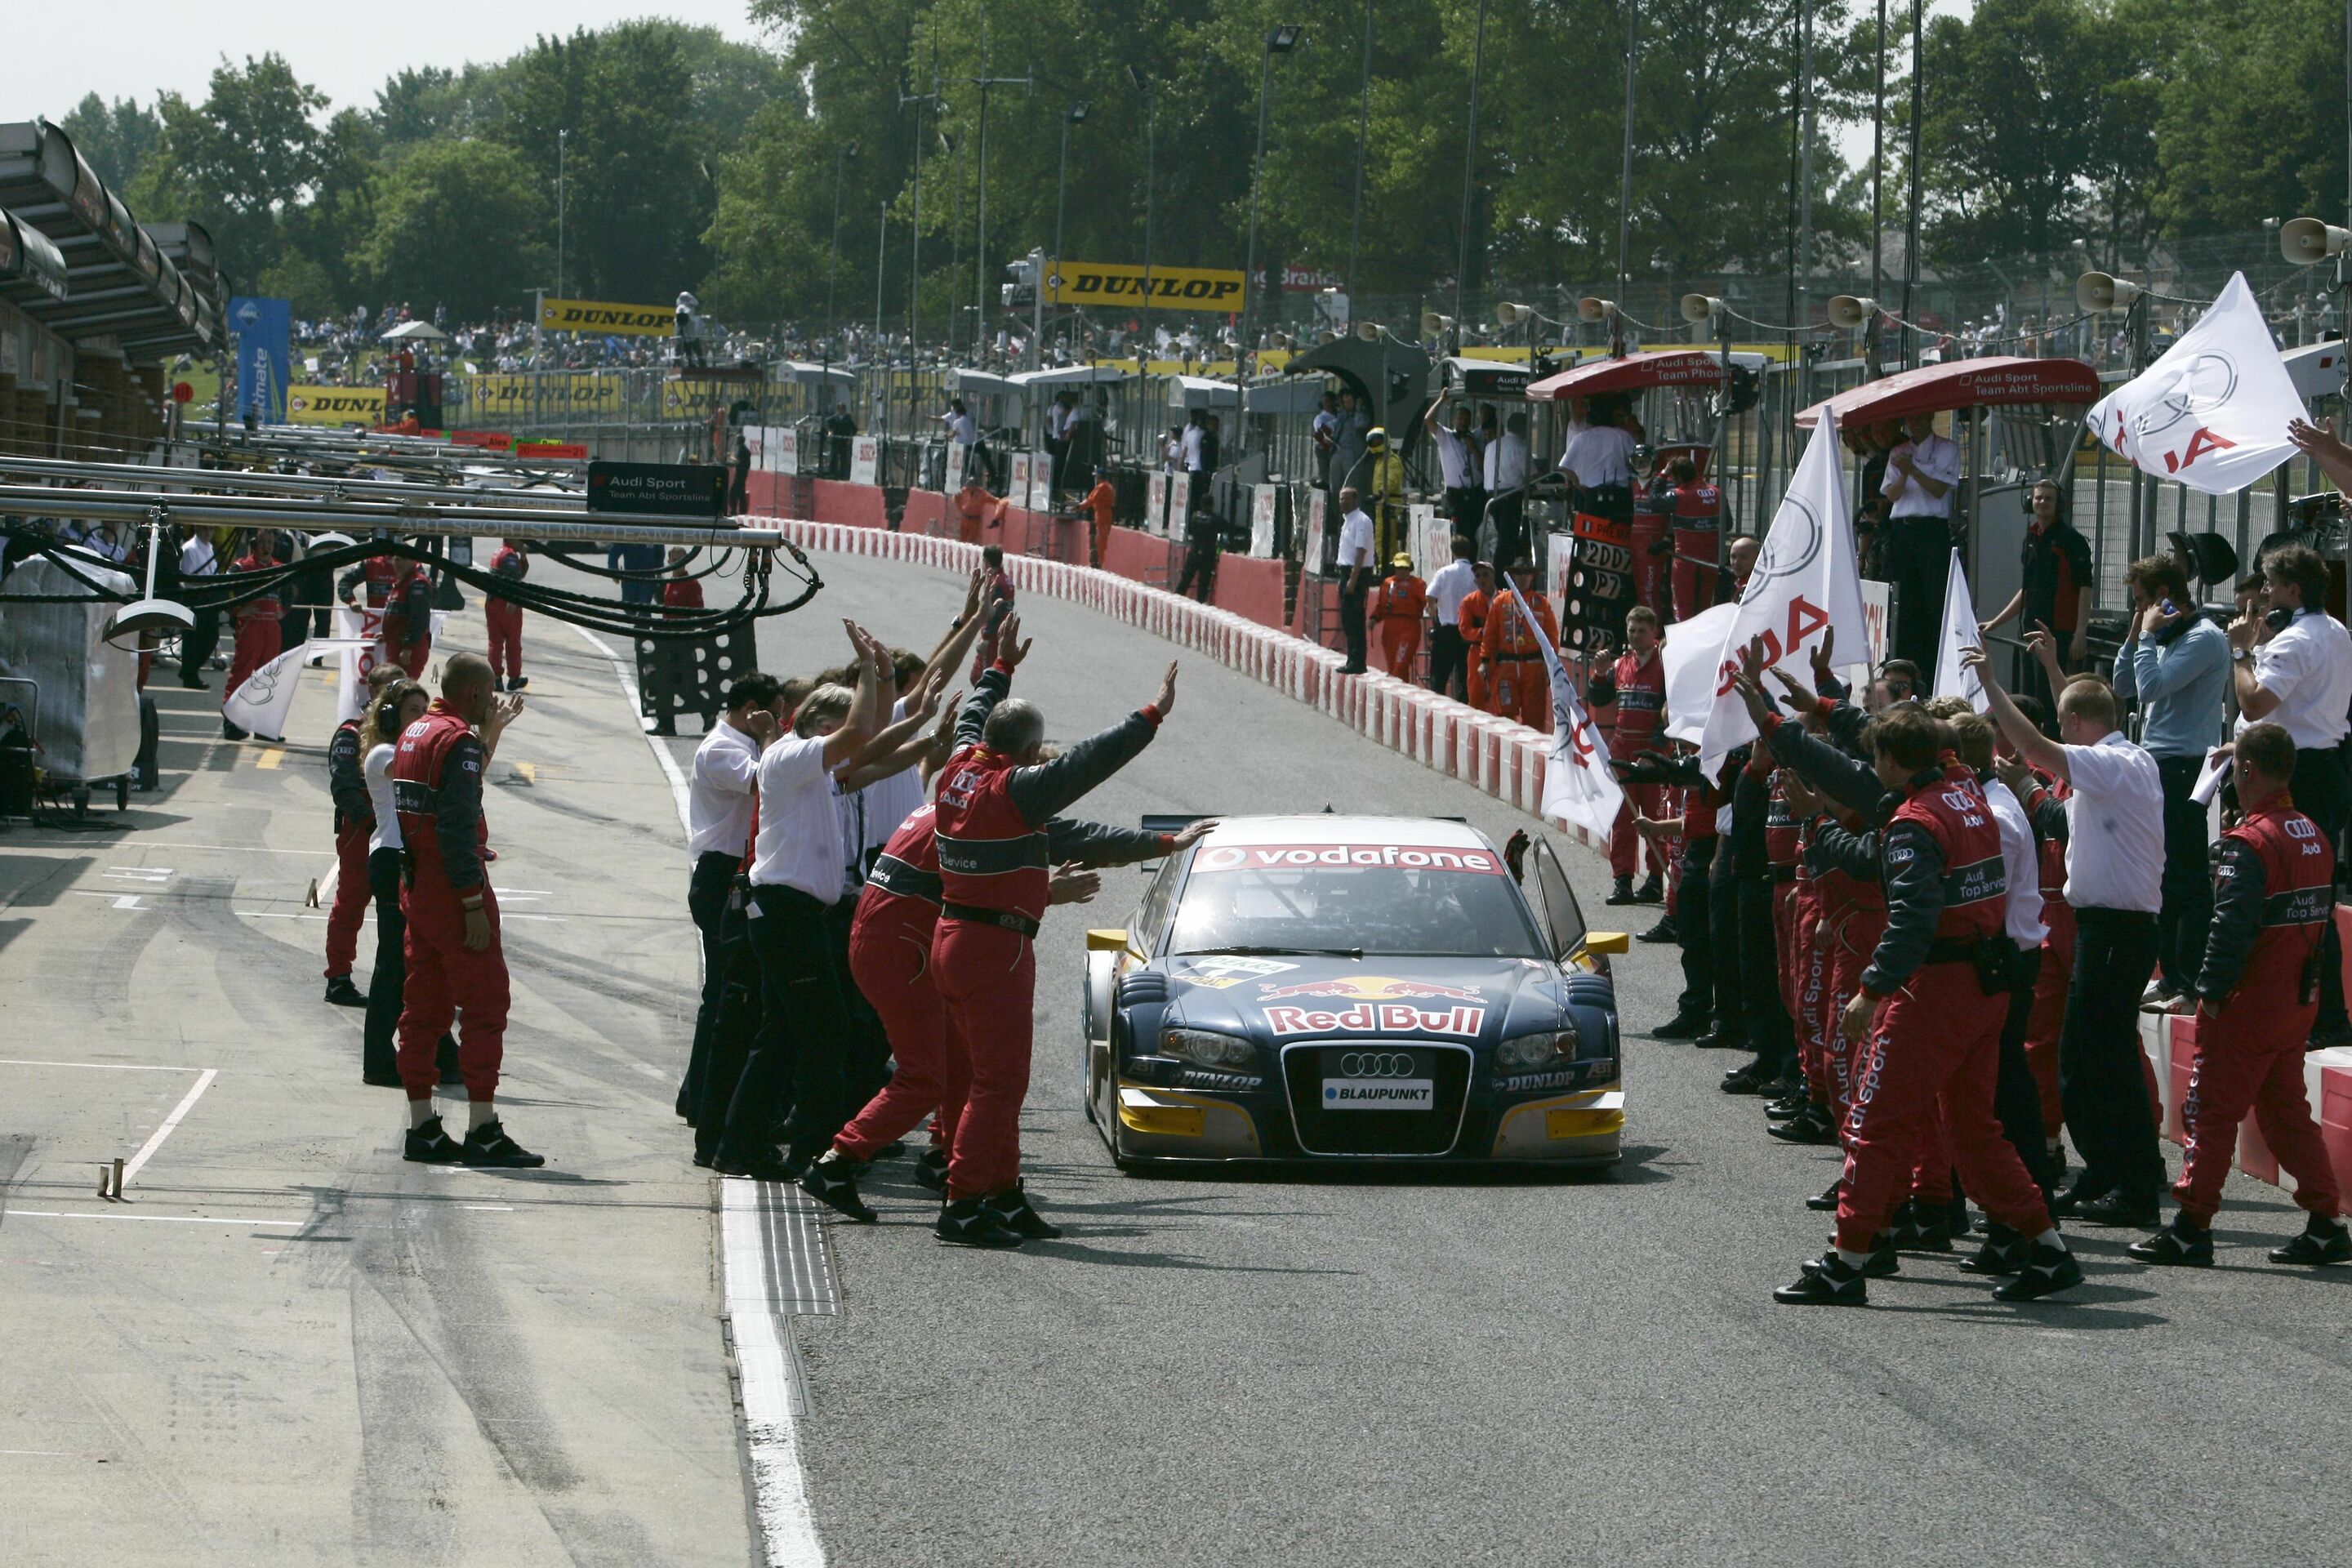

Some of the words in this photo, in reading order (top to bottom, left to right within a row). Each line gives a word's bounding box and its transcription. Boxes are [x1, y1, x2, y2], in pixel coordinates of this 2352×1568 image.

[1072, 274, 1241, 300] DUNLOP
[562, 308, 675, 328] DUNLOP
[1656, 358, 1691, 368] Audi
[1497, 376, 1519, 385] Audi
[1657, 370, 1687, 381] Team
[1975, 374, 2002, 383] Audi
[2005, 373, 2038, 383] Sport
[1975, 385, 2006, 396] Team
[2008, 384, 2029, 394] Abt
[2033, 382, 2092, 397] Sportsline
[489, 437, 507, 447] Alex
[519, 446, 530, 457] 20
[609, 476, 643, 488] Audi
[646, 477, 686, 490] Sport
[609, 491, 635, 499] Team
[638, 491, 656, 500] Abt
[658, 492, 710, 502] Sportsline
[399, 519, 442, 532] ABT
[683, 531, 743, 543] BLAU
[1595, 572, 1619, 597] P7
[940, 791, 969, 811] Audi
[2302, 842, 2321, 856] Audi
[942, 853, 978, 870] Service
[1255, 846, 1493, 871] vodafone
[1960, 884, 1981, 898] Top
[2292, 894, 2316, 906] Audi
[2286, 907, 2307, 919] Top
[1207, 957, 1285, 972] DEKRA
[1804, 951, 1824, 1004] Sport
[1268, 1004, 1374, 1033] Red
[1382, 1005, 1481, 1035] Bull
[1803, 1006, 1824, 1046] Audi
[1126, 1061, 1160, 1076] ABT
[1859, 1036, 1891, 1104] Sport
[1182, 1070, 1263, 1090] DUNLOP
[1506, 1071, 1575, 1092] DUNLOP
[1833, 1057, 1851, 1106] Audi
[1339, 1088, 1430, 1101] BLAUPUNKT
